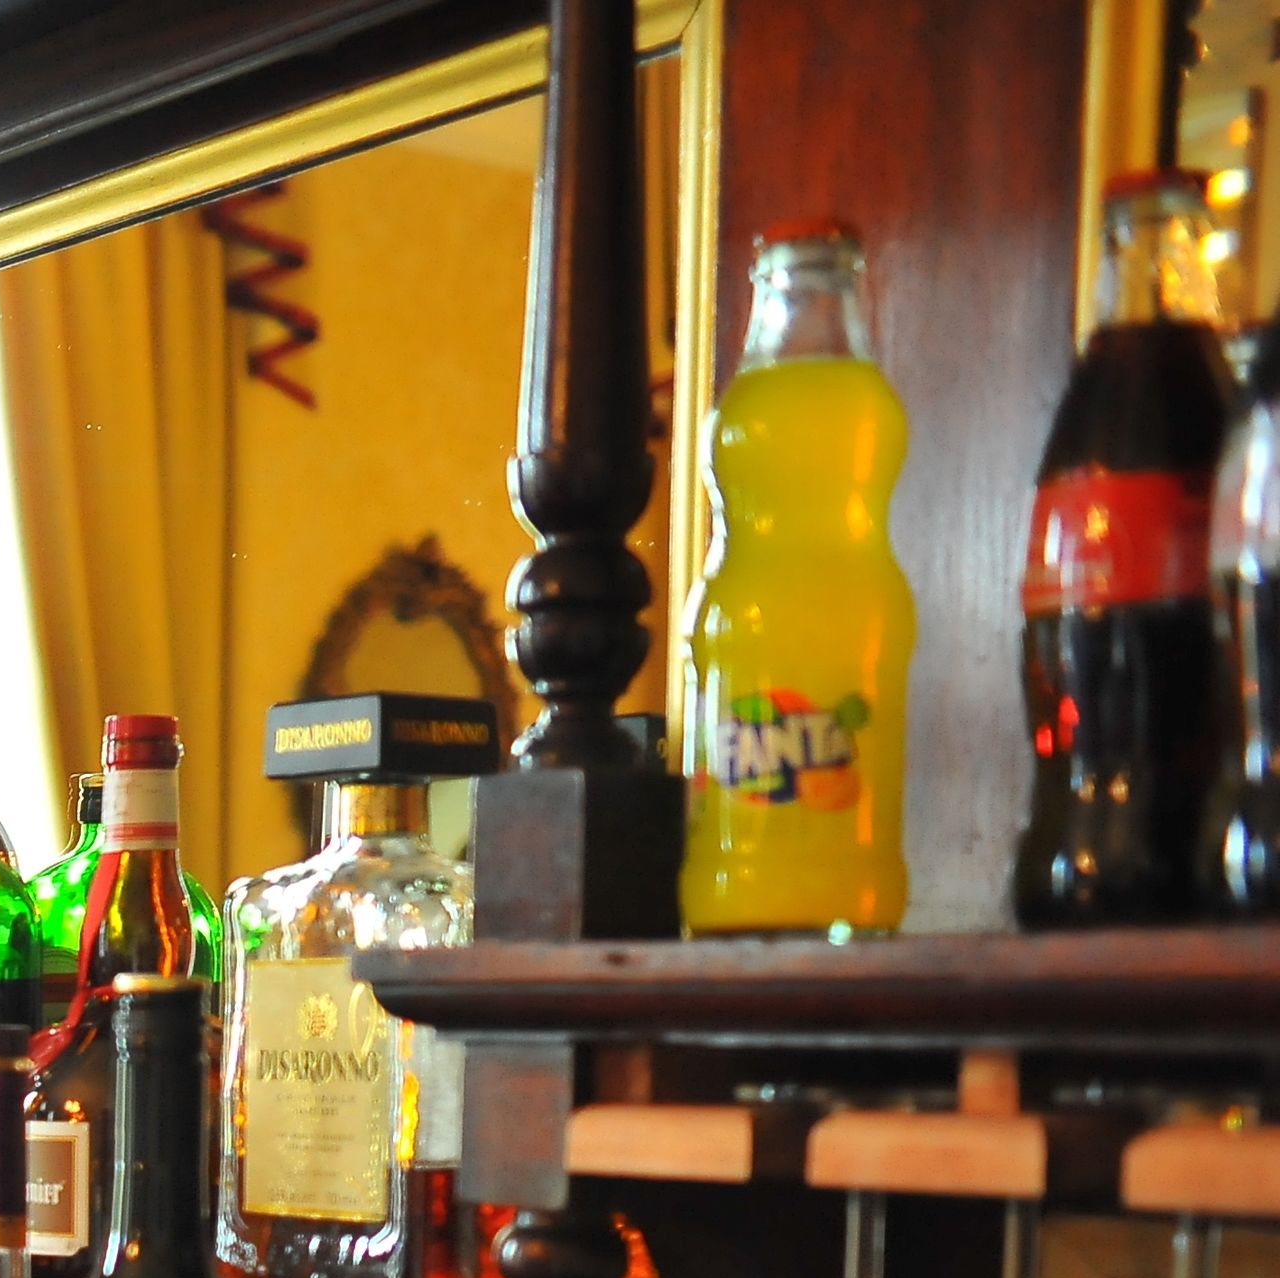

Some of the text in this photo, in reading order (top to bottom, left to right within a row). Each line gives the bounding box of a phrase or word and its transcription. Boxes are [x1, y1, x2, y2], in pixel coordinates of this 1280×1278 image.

[274, 717, 373, 755] DISARONNO
[716, 713, 855, 788] FANTA
[257, 1048, 380, 1084] DISARONNO
